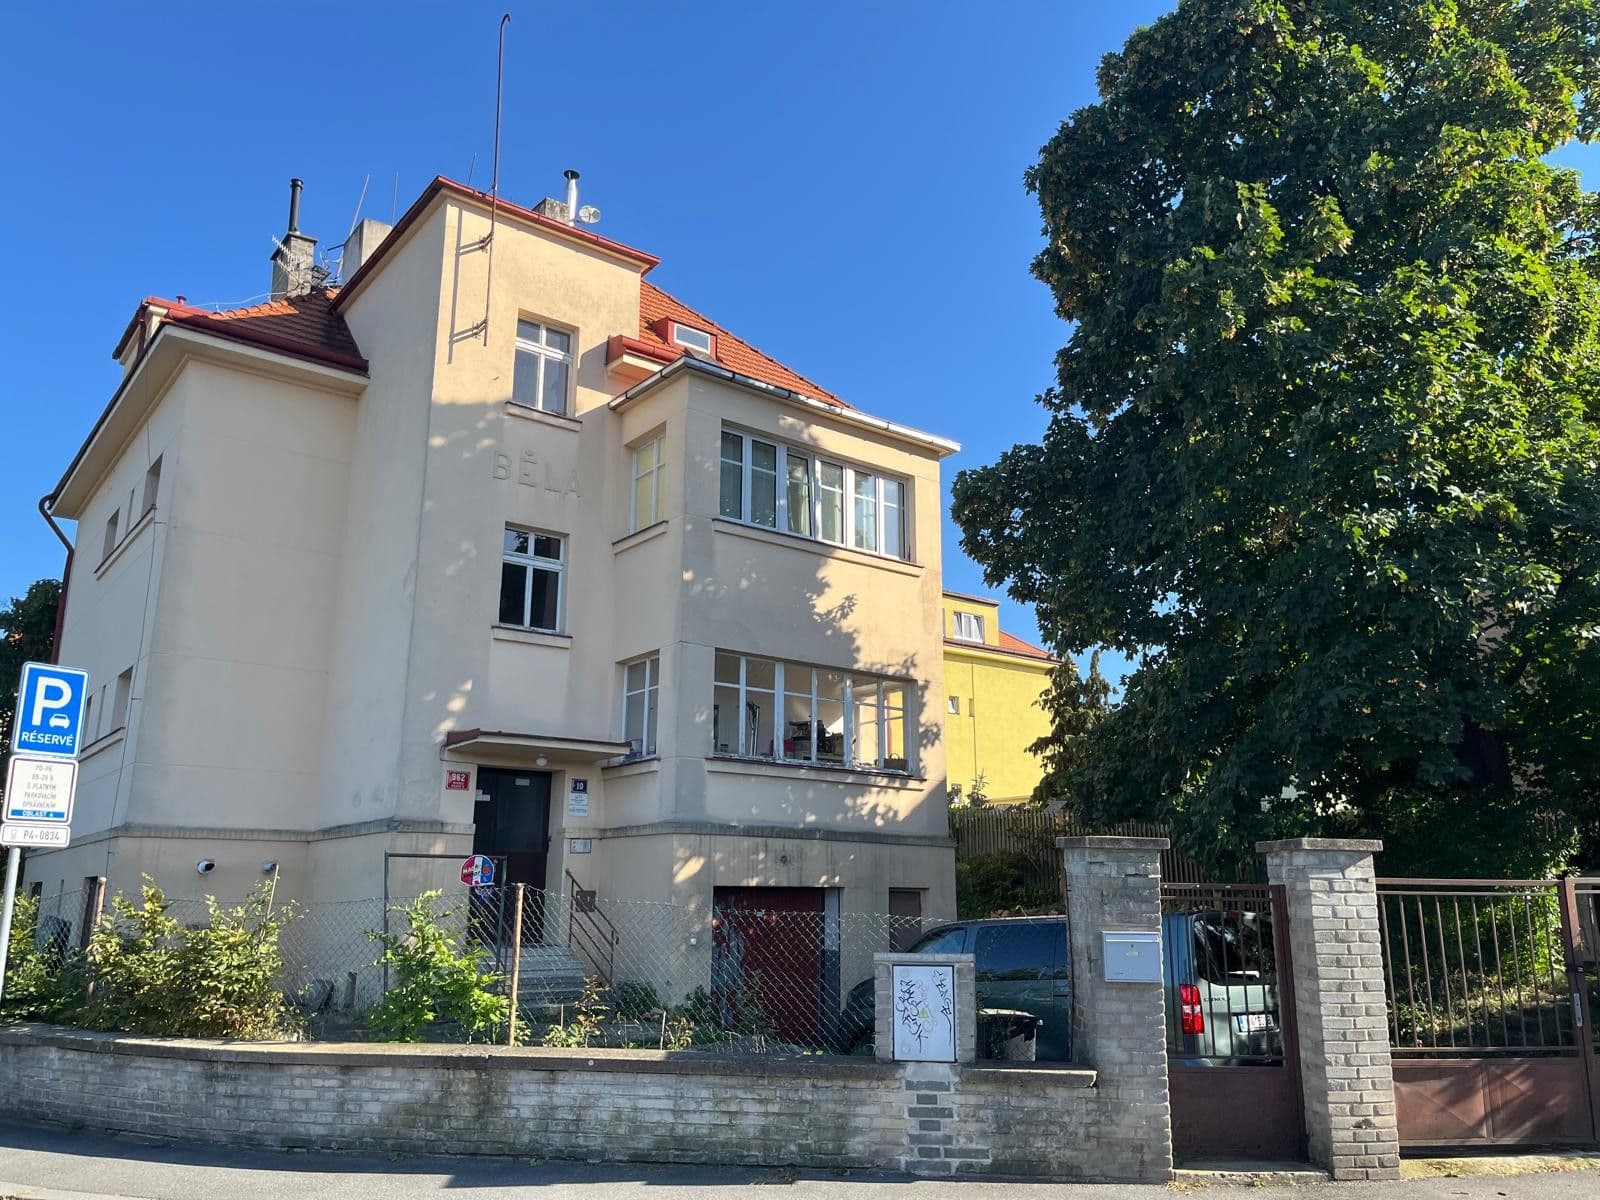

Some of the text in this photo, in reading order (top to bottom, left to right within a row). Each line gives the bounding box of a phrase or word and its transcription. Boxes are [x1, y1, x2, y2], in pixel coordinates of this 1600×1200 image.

[32, 676, 72, 726] P
[21, 729, 74, 746] RÉSERVÉ
[576, 782, 584, 790] 10
[23, 830, 60, 840] P4-0834
